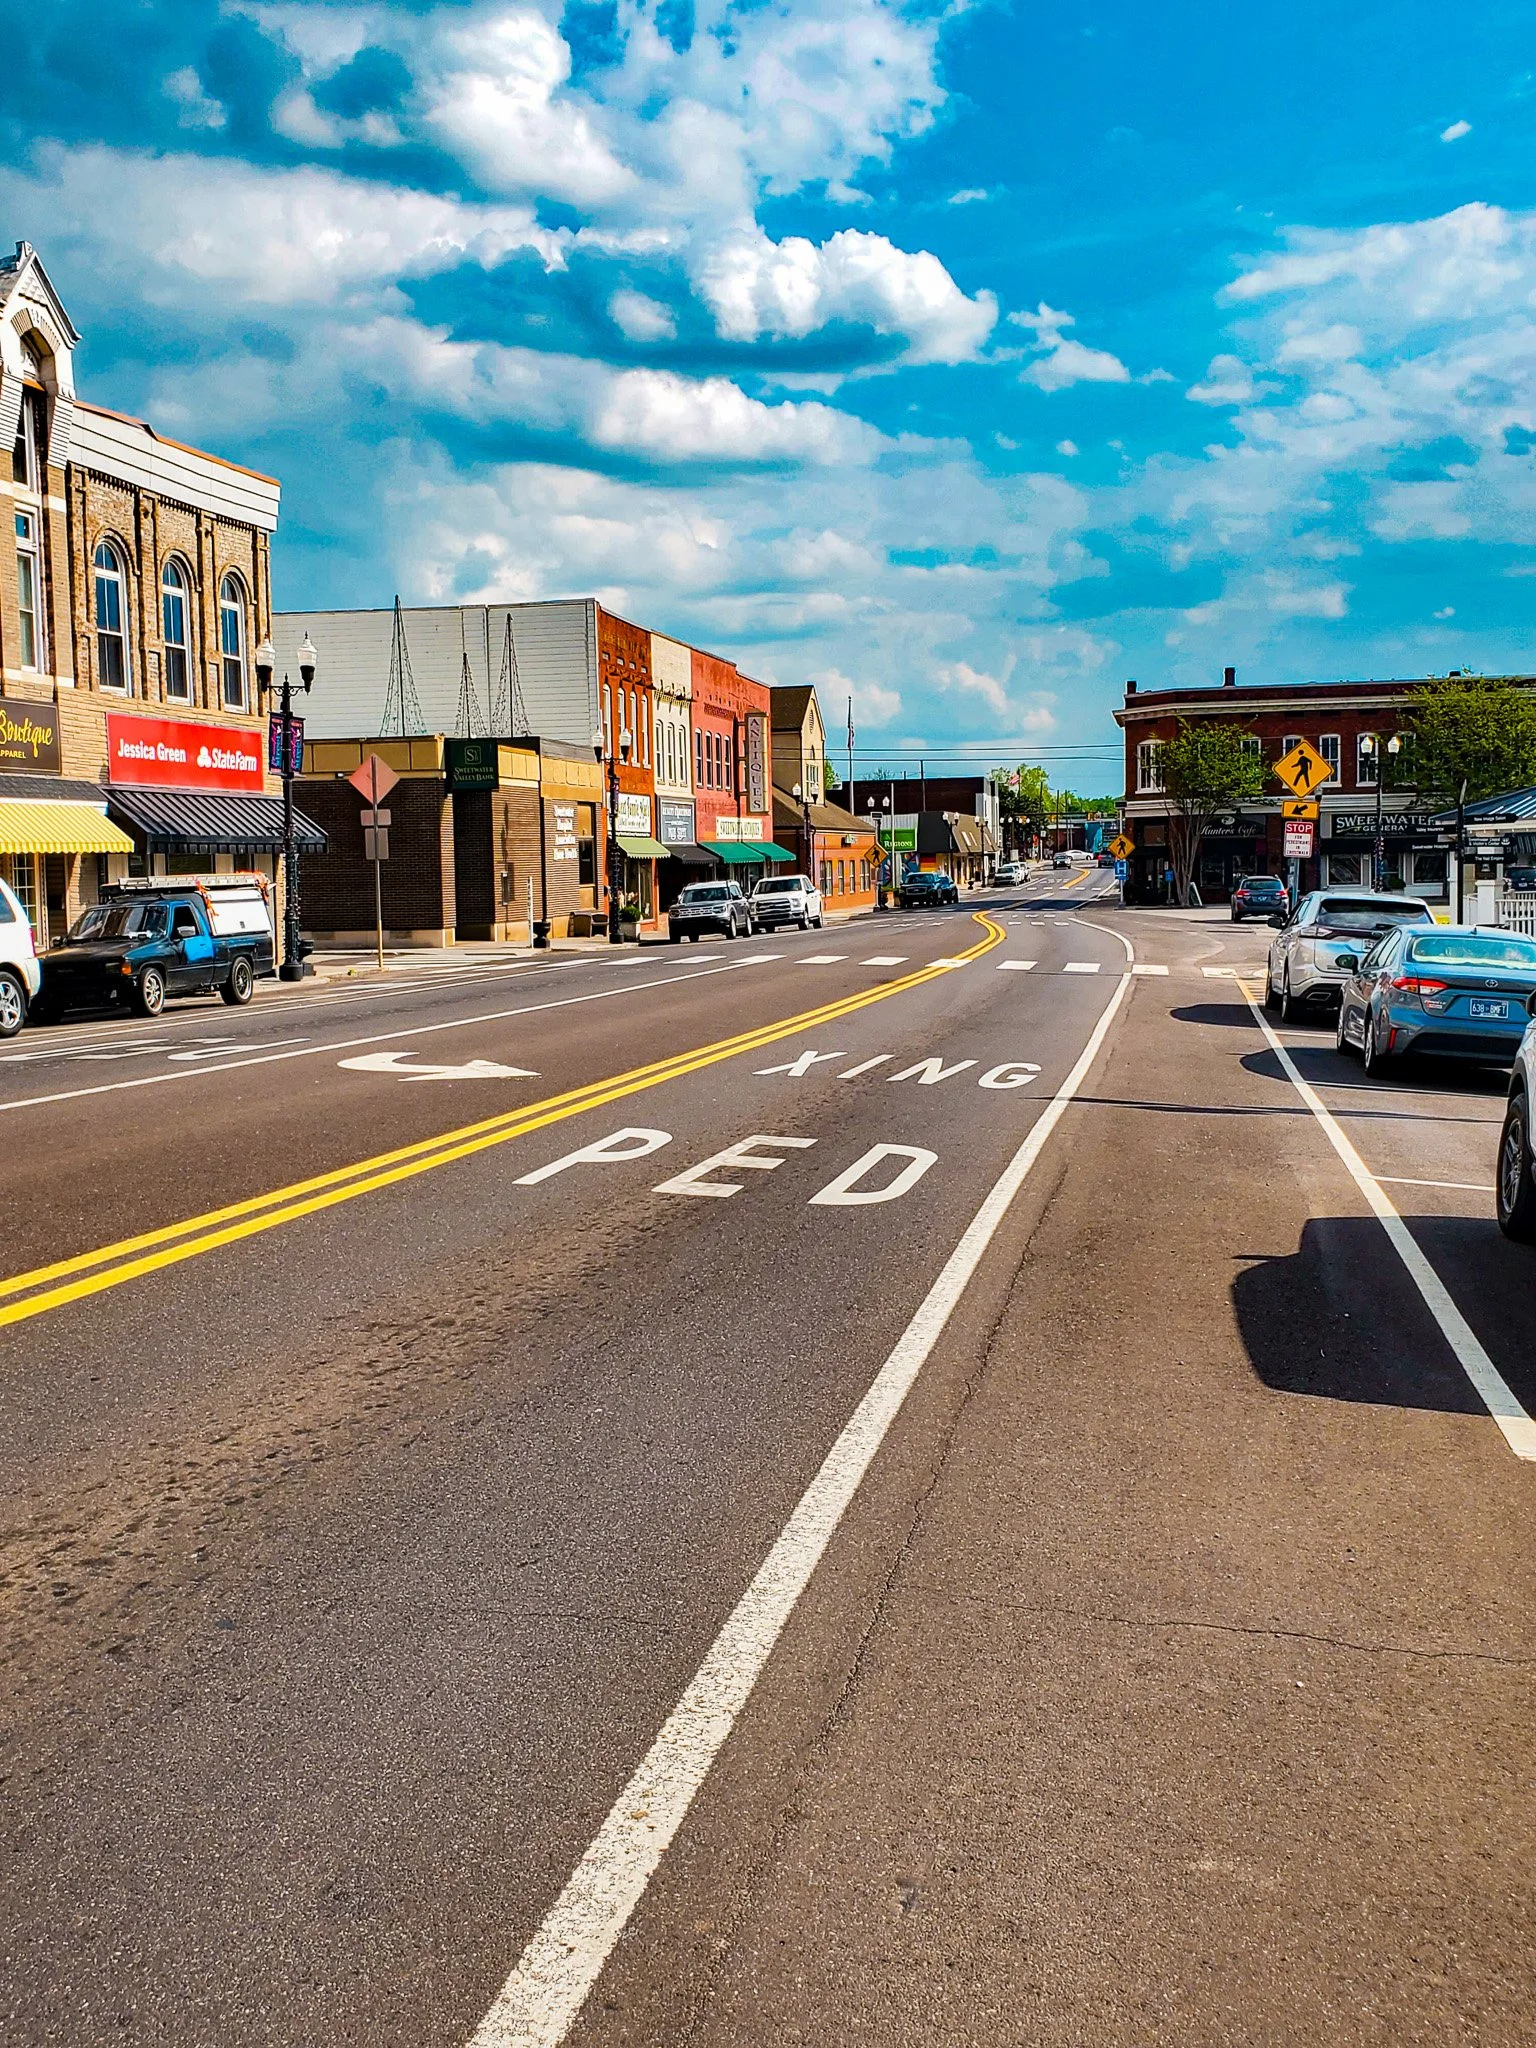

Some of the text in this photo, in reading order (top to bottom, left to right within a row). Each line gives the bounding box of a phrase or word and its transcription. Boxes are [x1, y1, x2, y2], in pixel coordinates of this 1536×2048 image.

[0, 749, 26, 759] PPAREL
[118, 738, 155, 760] Jessica
[157, 742, 187, 763] Green
[750, 718, 762, 809] ANTIQUES
[1286, 823, 1312, 833] STOP
[1116, 862, 1127, 874] H
[1472, 1003, 1485, 1013] 638
[751, 1050, 1042, 1090] XING
[511, 1126, 939, 1207] PED
